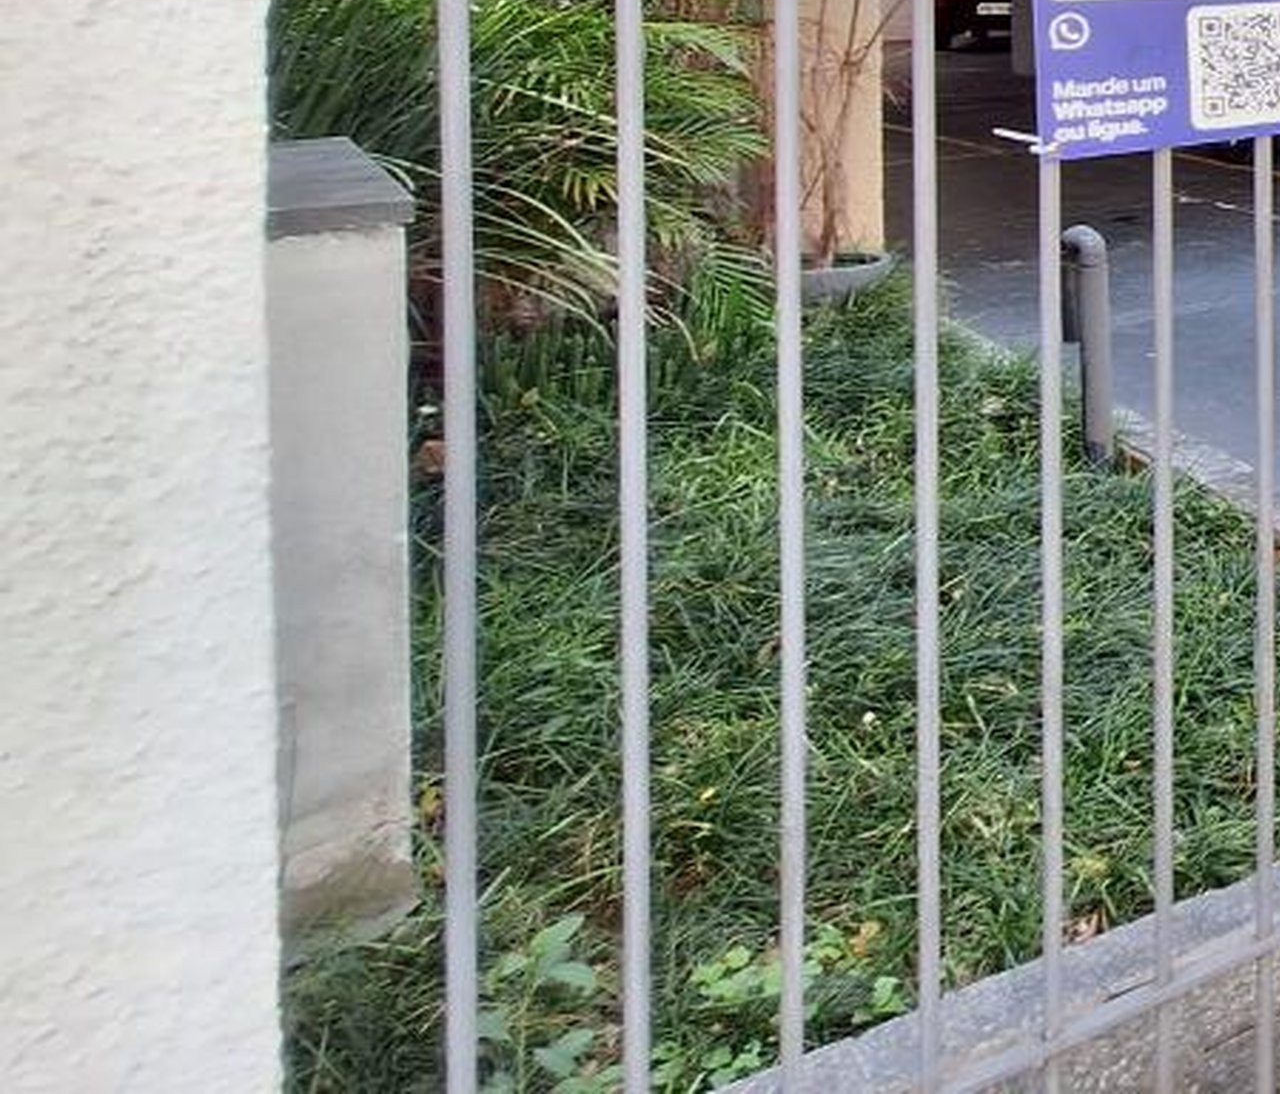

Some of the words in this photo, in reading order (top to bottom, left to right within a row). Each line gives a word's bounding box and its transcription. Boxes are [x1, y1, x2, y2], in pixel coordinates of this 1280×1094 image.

[1052, 76, 1129, 100] Mande
[1131, 76, 1167, 93] um
[1051, 97, 1168, 121] Whatsapp
[1053, 125, 1086, 143] ou
